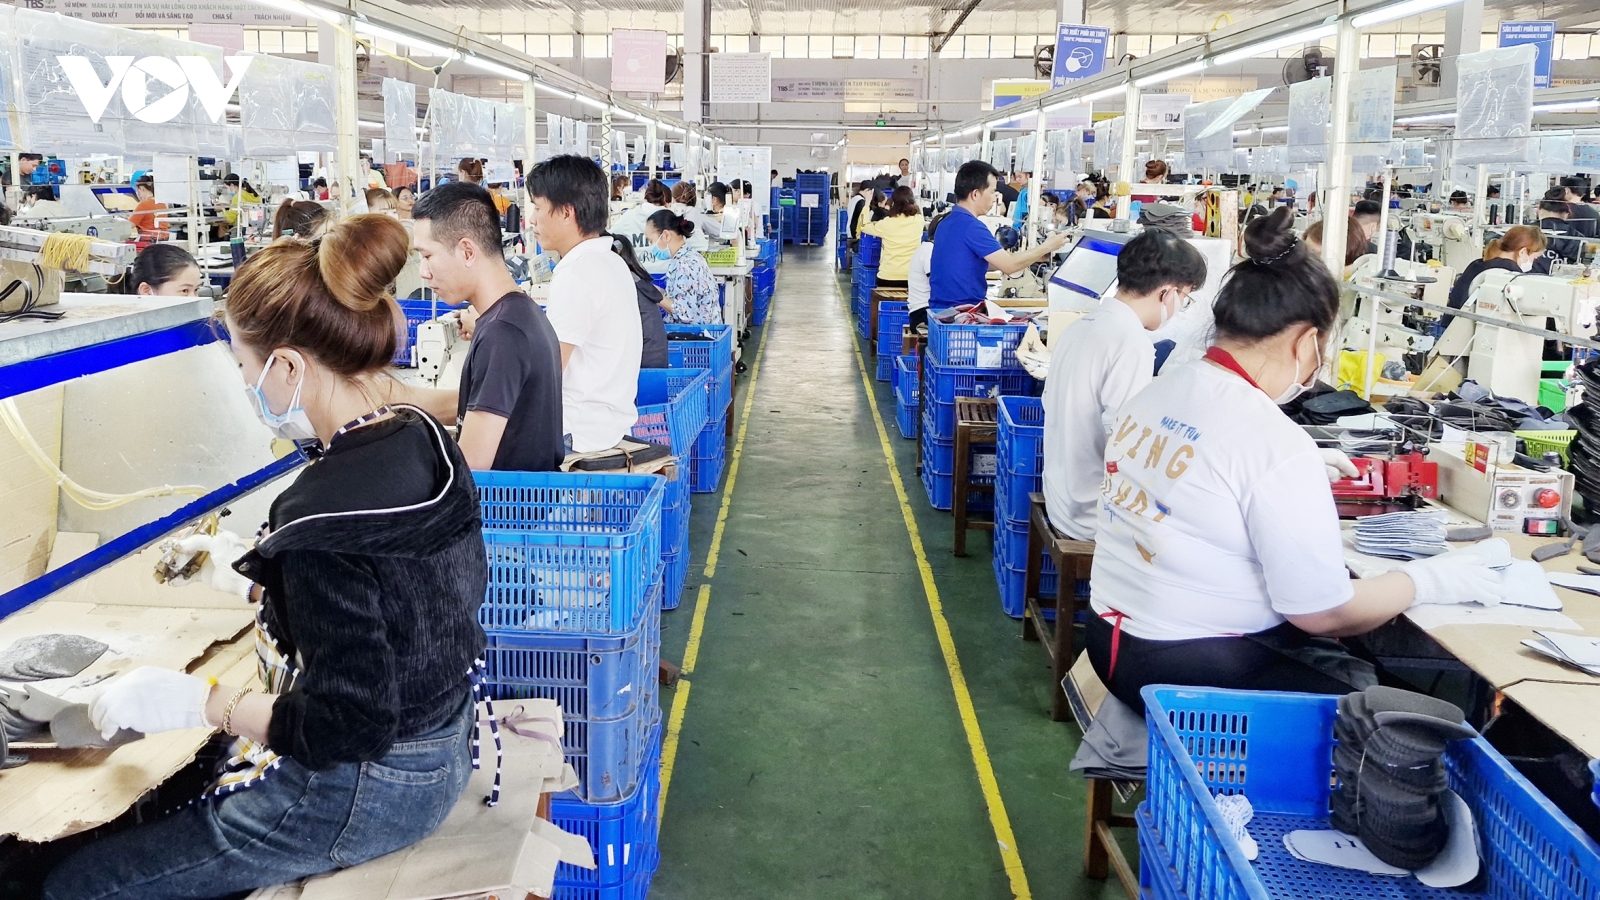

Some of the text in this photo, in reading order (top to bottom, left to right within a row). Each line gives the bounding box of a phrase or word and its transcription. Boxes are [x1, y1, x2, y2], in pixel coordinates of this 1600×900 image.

[1113, 414, 1195, 480] VING
[1160, 416, 1203, 442] MAKE IT FUN
